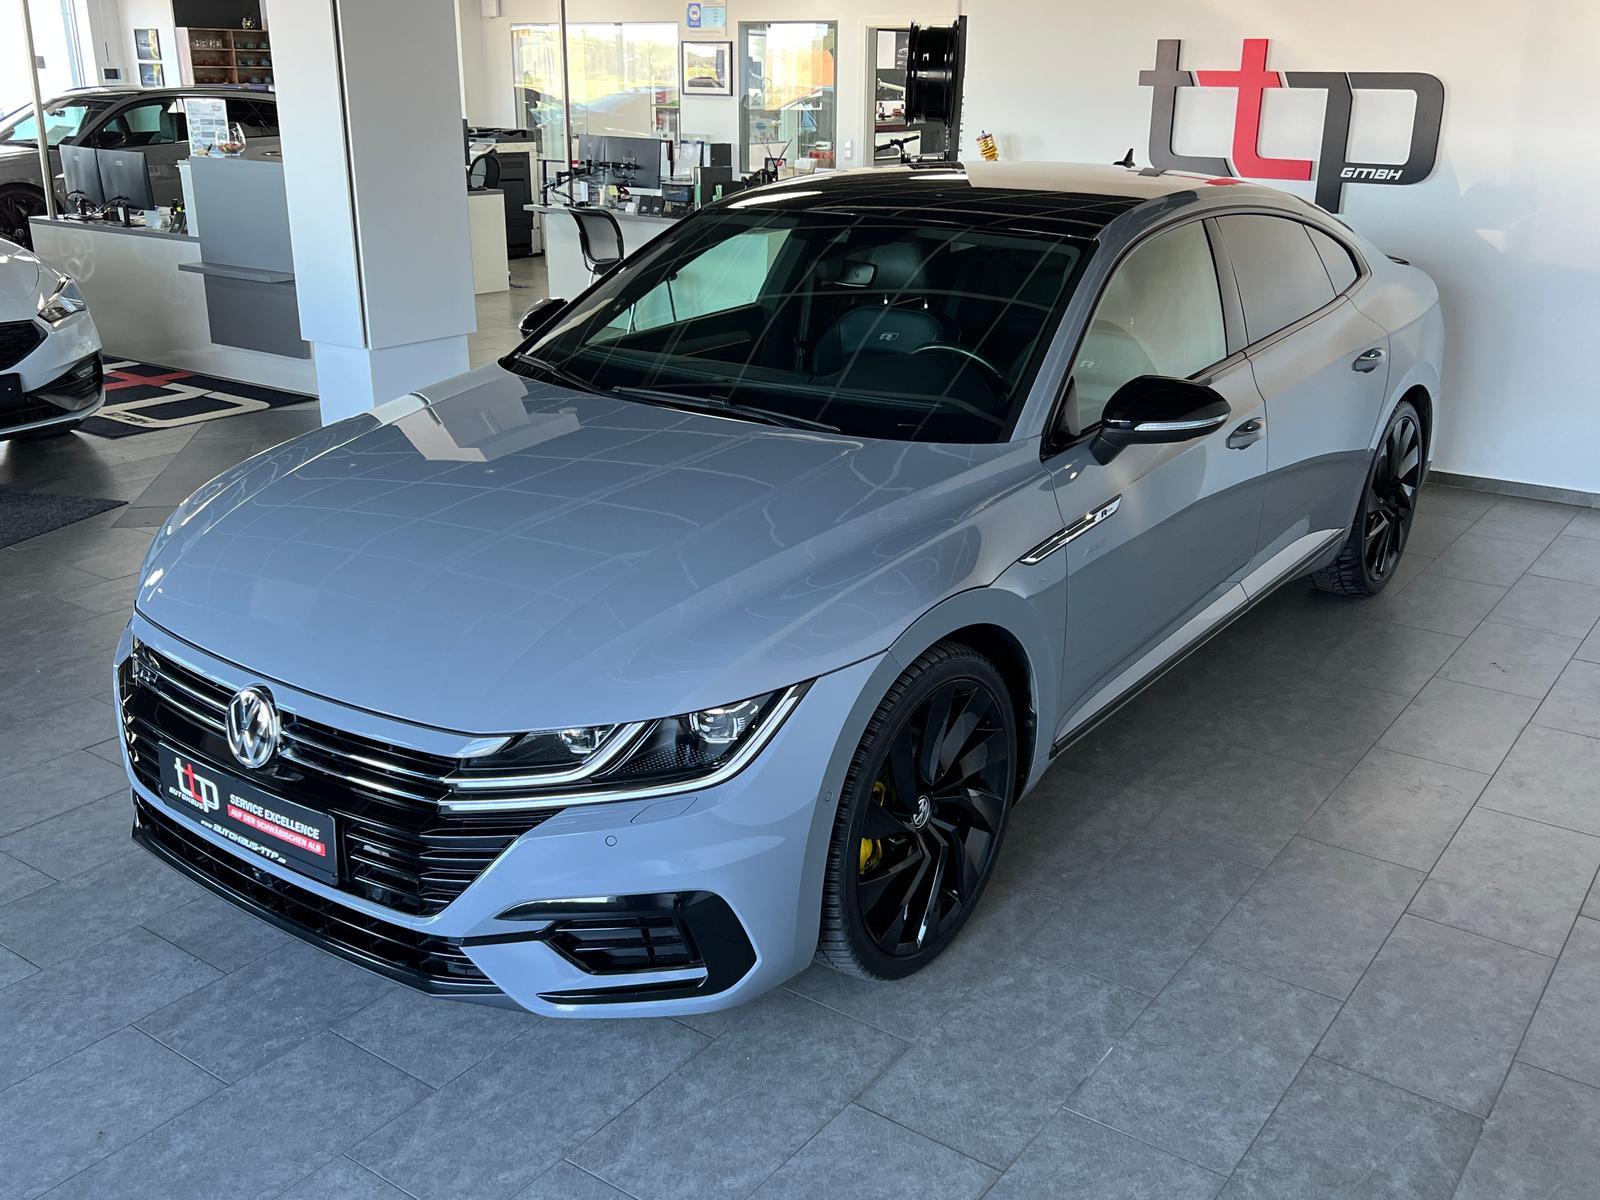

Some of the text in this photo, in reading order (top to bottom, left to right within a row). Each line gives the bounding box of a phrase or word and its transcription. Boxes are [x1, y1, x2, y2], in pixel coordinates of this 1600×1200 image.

[1138, 38, 1444, 214] ttp
[1340, 167, 1403, 180] GMBH
[227, 687, 277, 768] VW
[174, 757, 219, 813] ttp
[229, 793, 320, 840] SERVICE EXCELLENCE
[230, 808, 243, 819] AUF
[308, 841, 322, 853] ALB
